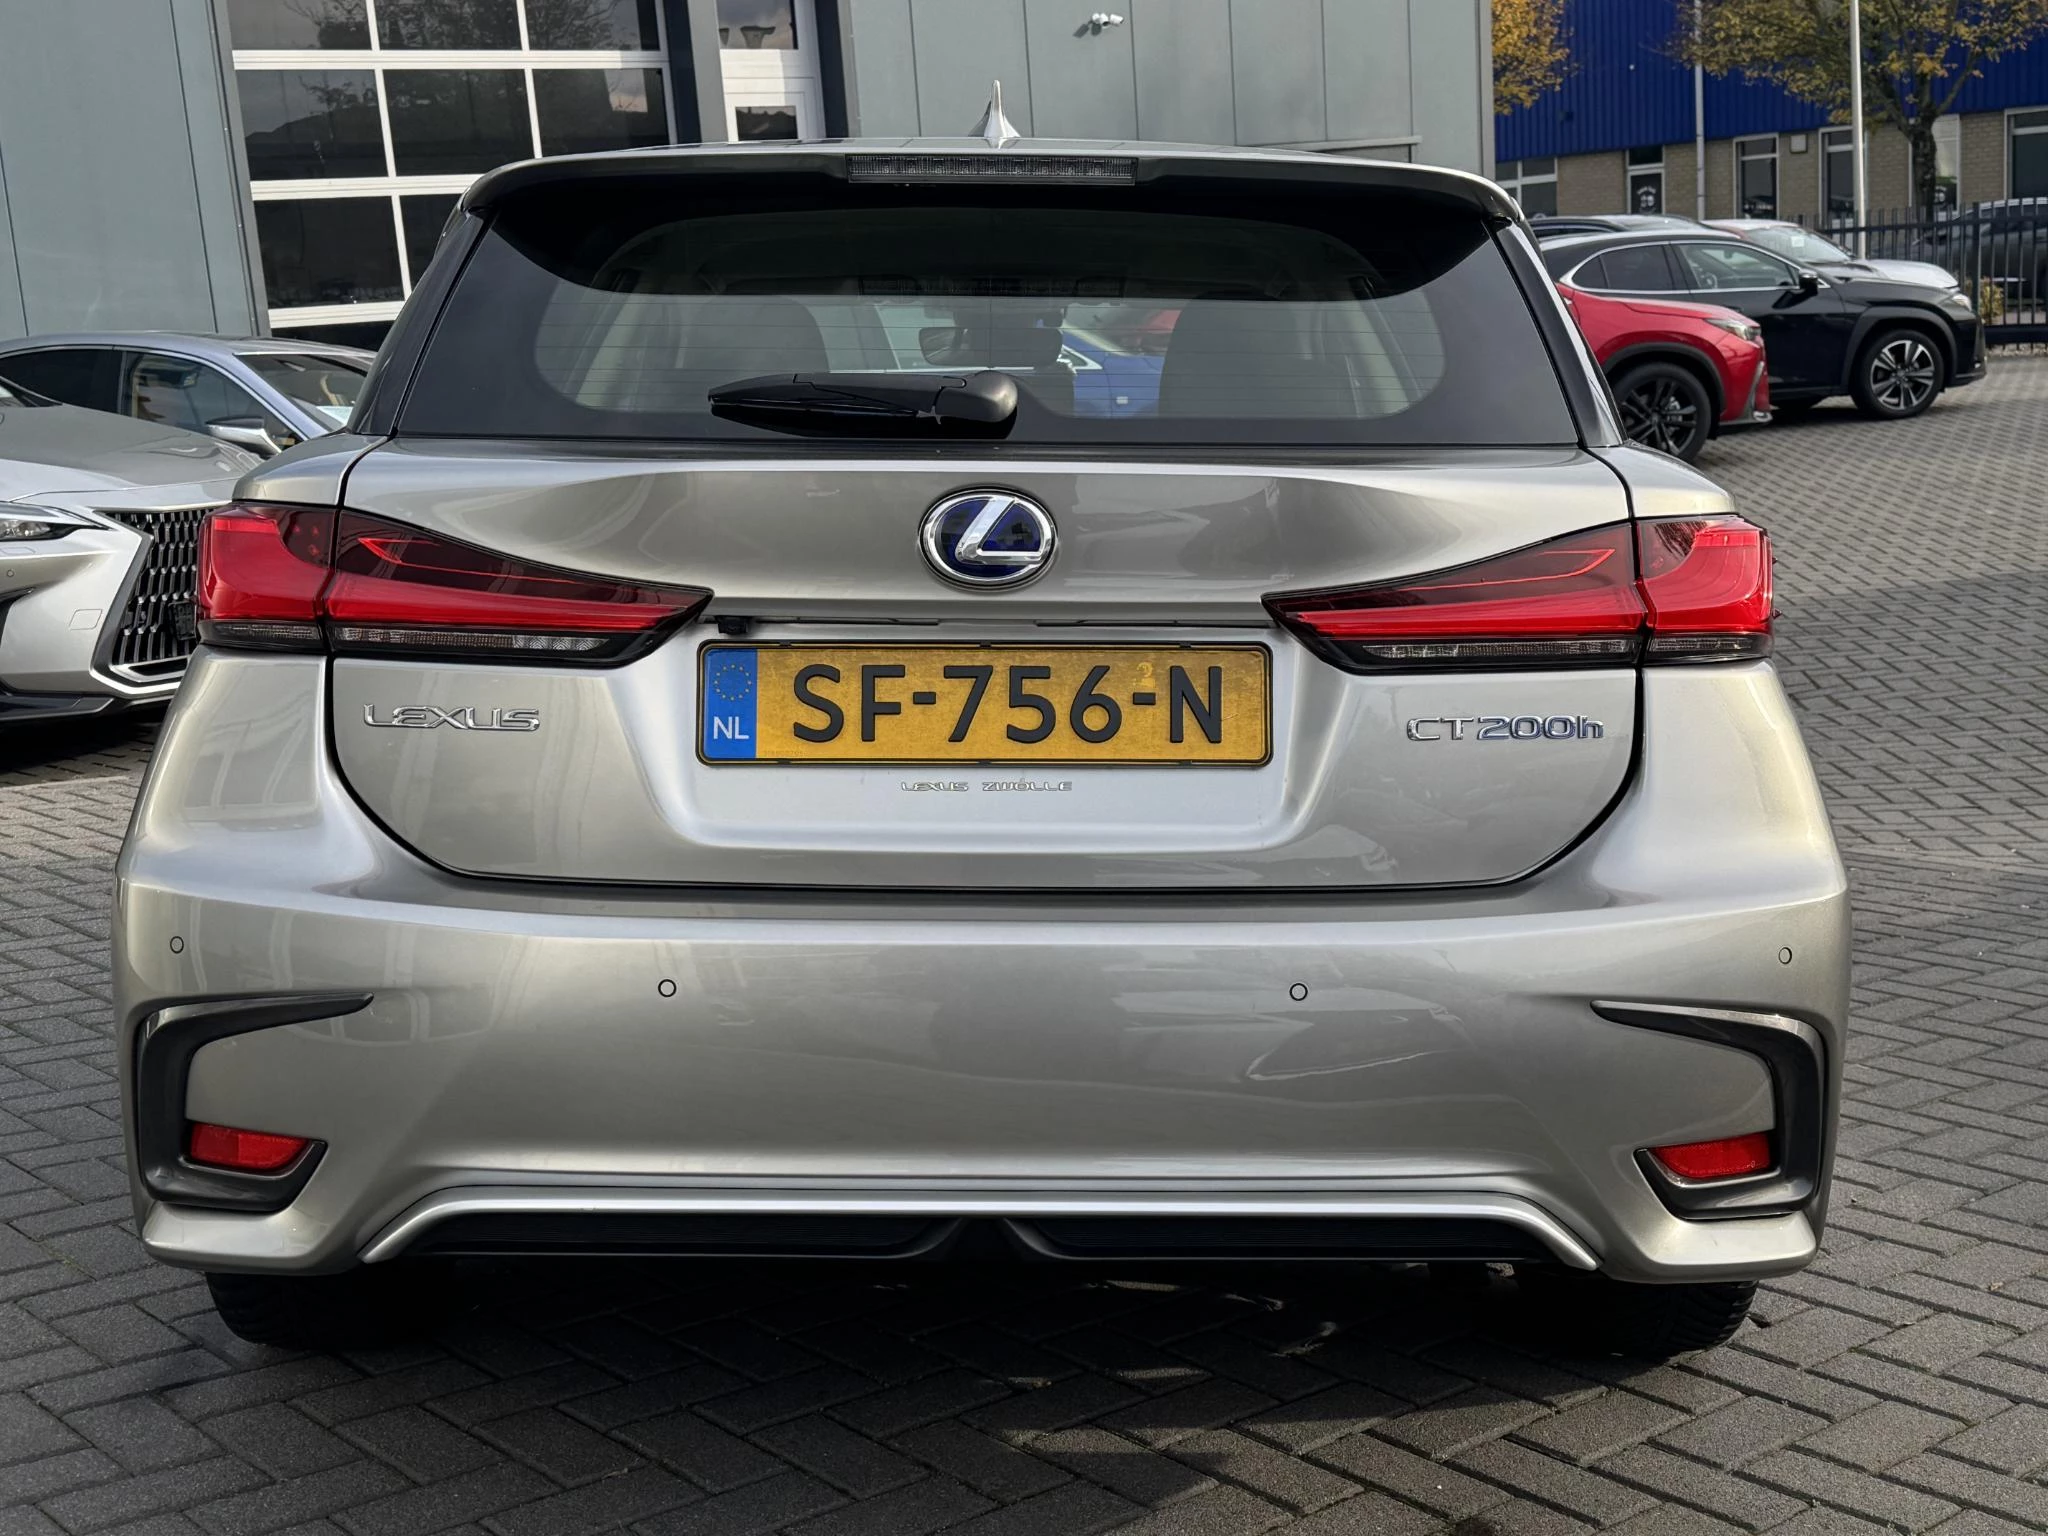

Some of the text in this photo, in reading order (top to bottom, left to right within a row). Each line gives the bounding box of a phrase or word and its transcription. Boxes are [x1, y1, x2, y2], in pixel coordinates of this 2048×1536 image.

[793, 664, 1222, 743] SF-756-N
[363, 704, 540, 732] LEXUS
[713, 716, 749, 739] NL
[901, 780, 1073, 792] LEXUS ZWOLLE
